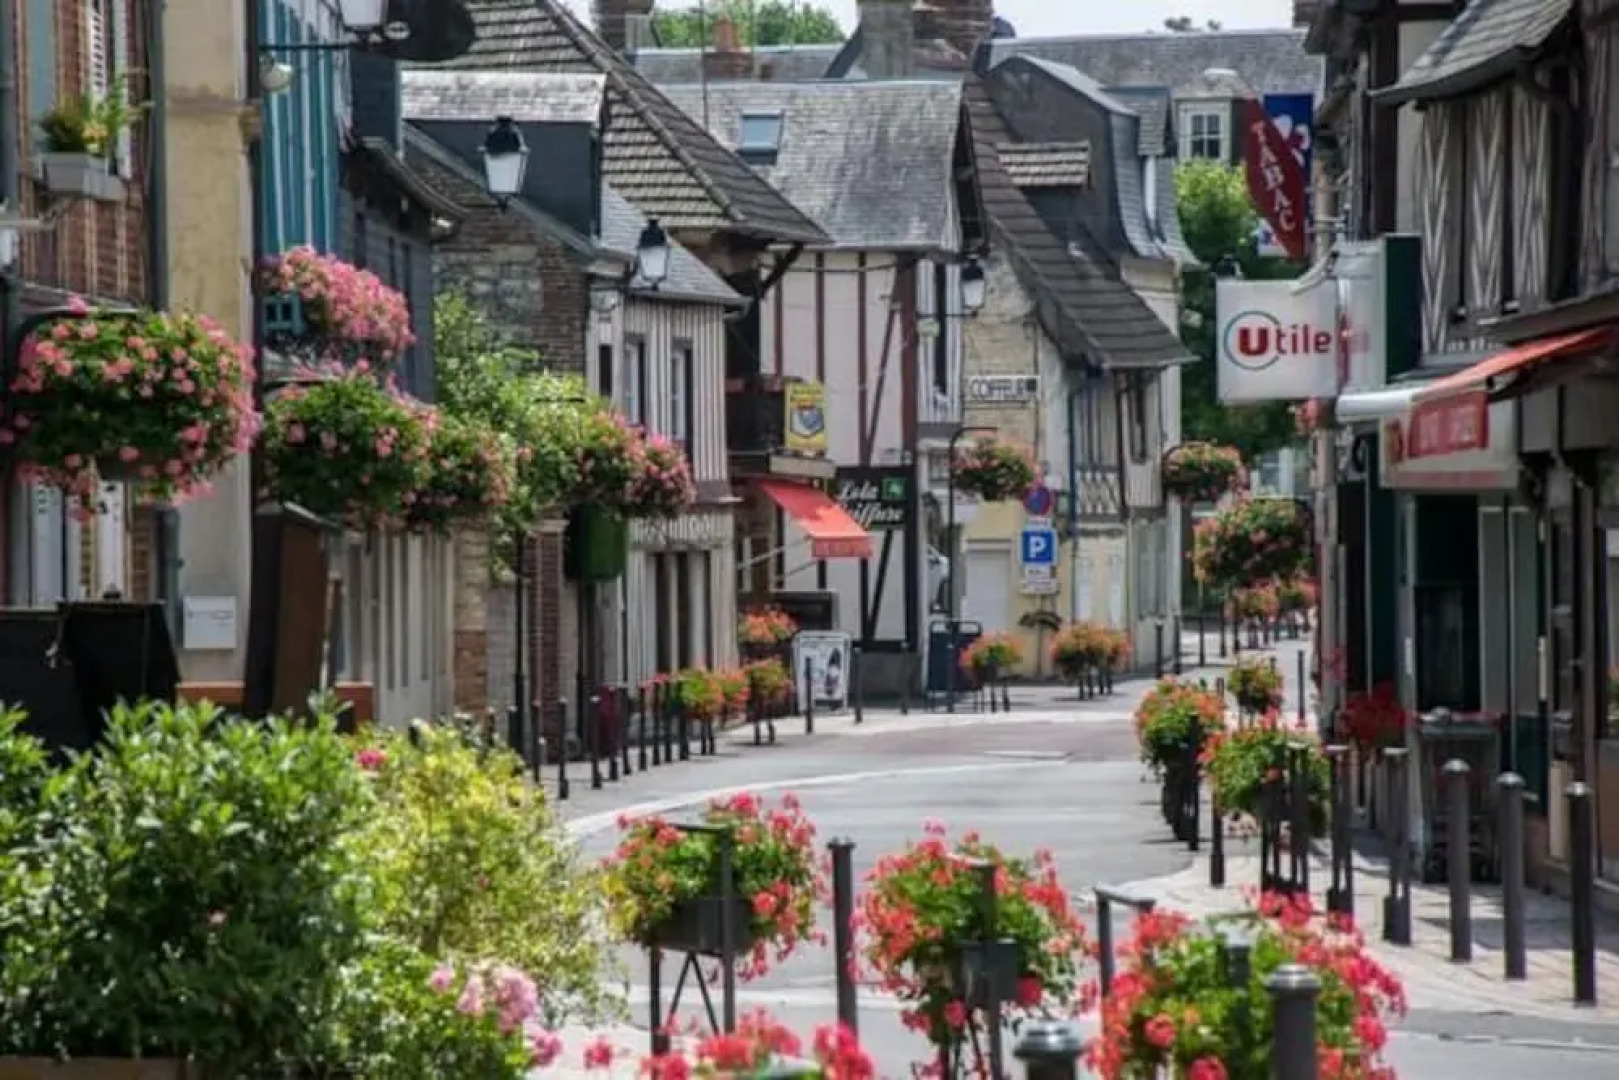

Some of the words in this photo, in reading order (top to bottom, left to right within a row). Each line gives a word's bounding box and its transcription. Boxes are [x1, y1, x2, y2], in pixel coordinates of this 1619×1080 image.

[1251, 120, 1296, 232] TABAC
[1237, 322, 1332, 357] Utile
[1028, 535, 1047, 558] P
